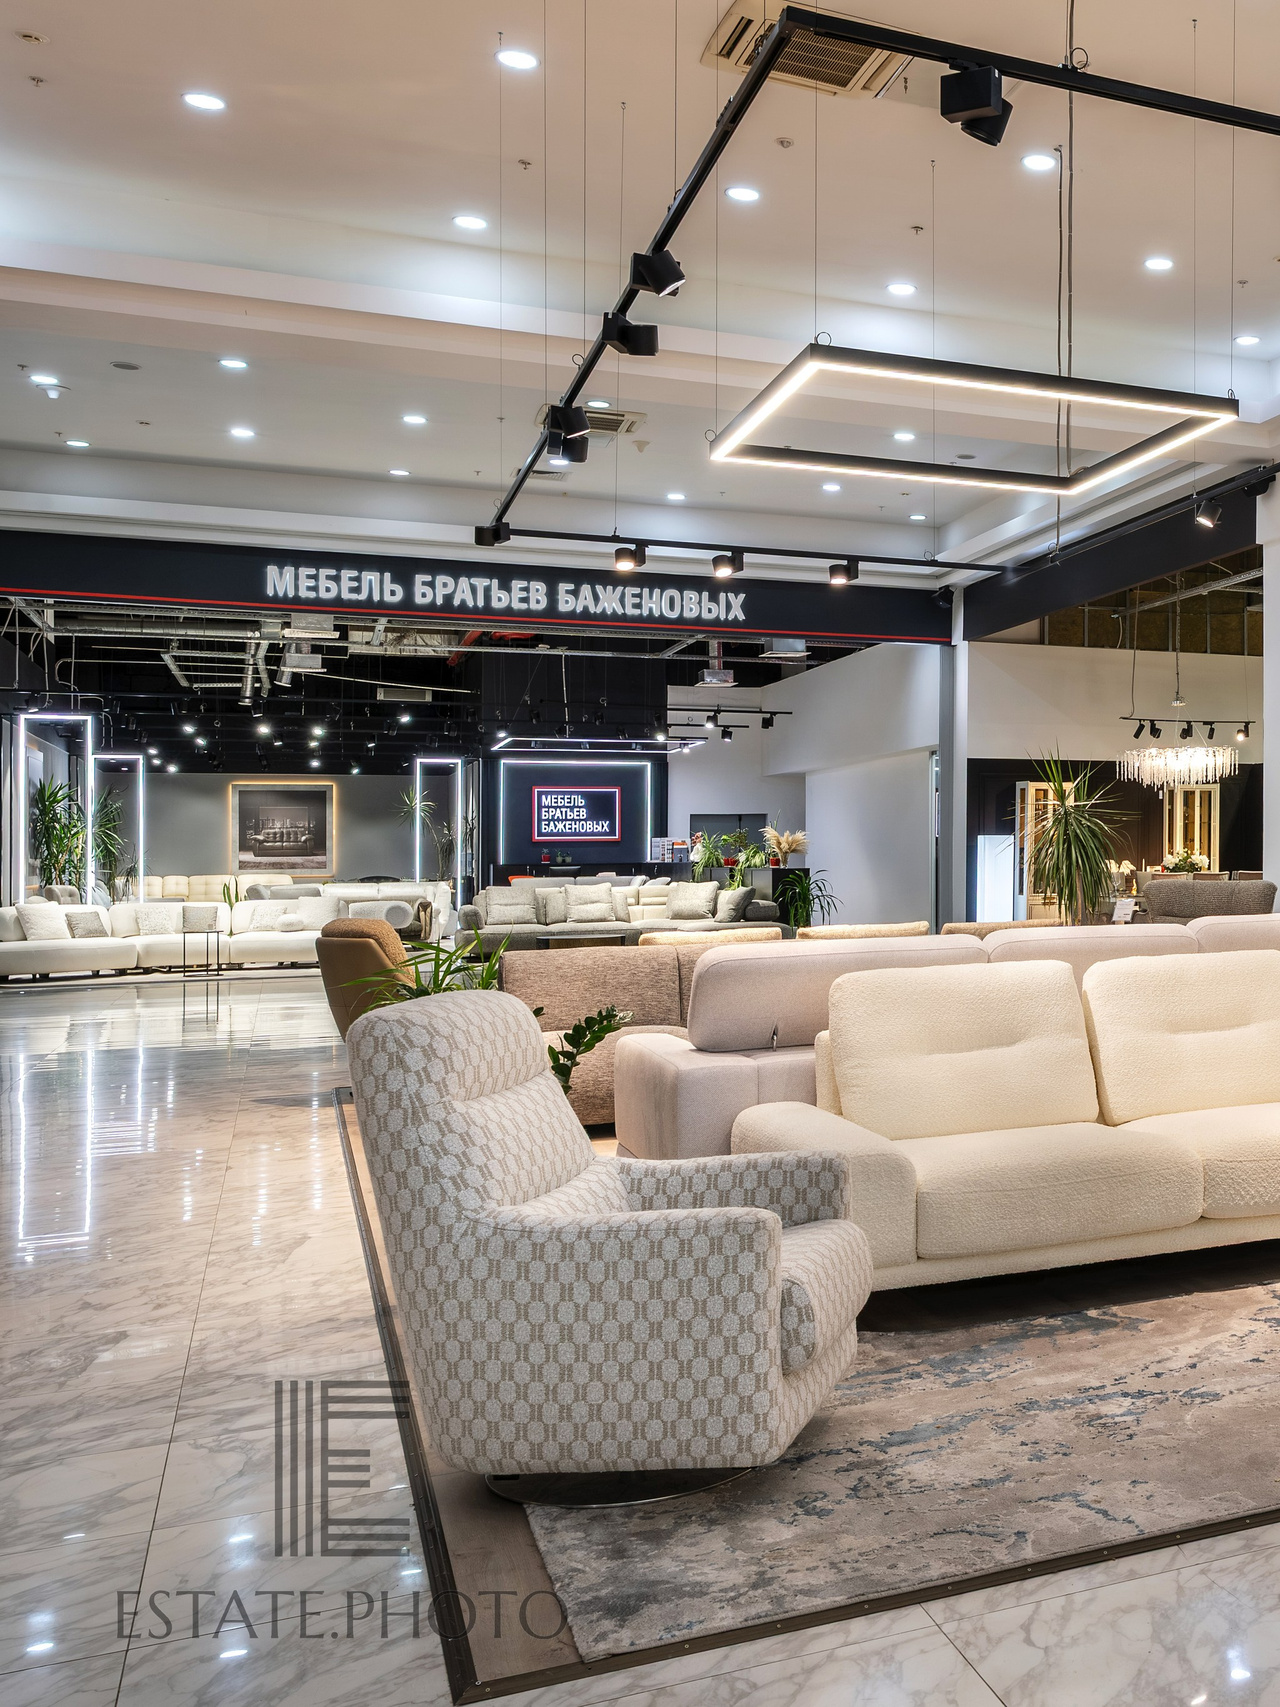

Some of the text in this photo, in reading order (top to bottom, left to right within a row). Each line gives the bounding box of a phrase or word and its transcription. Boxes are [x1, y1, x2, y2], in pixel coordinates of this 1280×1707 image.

[266, 565, 746, 621] МЕБЕЛЬ БРАТЬЕВ БАЖЕНОВЫХ
[541, 795, 585, 807] МЕБЕЛЬ
[541, 808, 587, 820] БРАТЬЕВ
[541, 821, 610, 833] БАЖЕНОВЫХ
